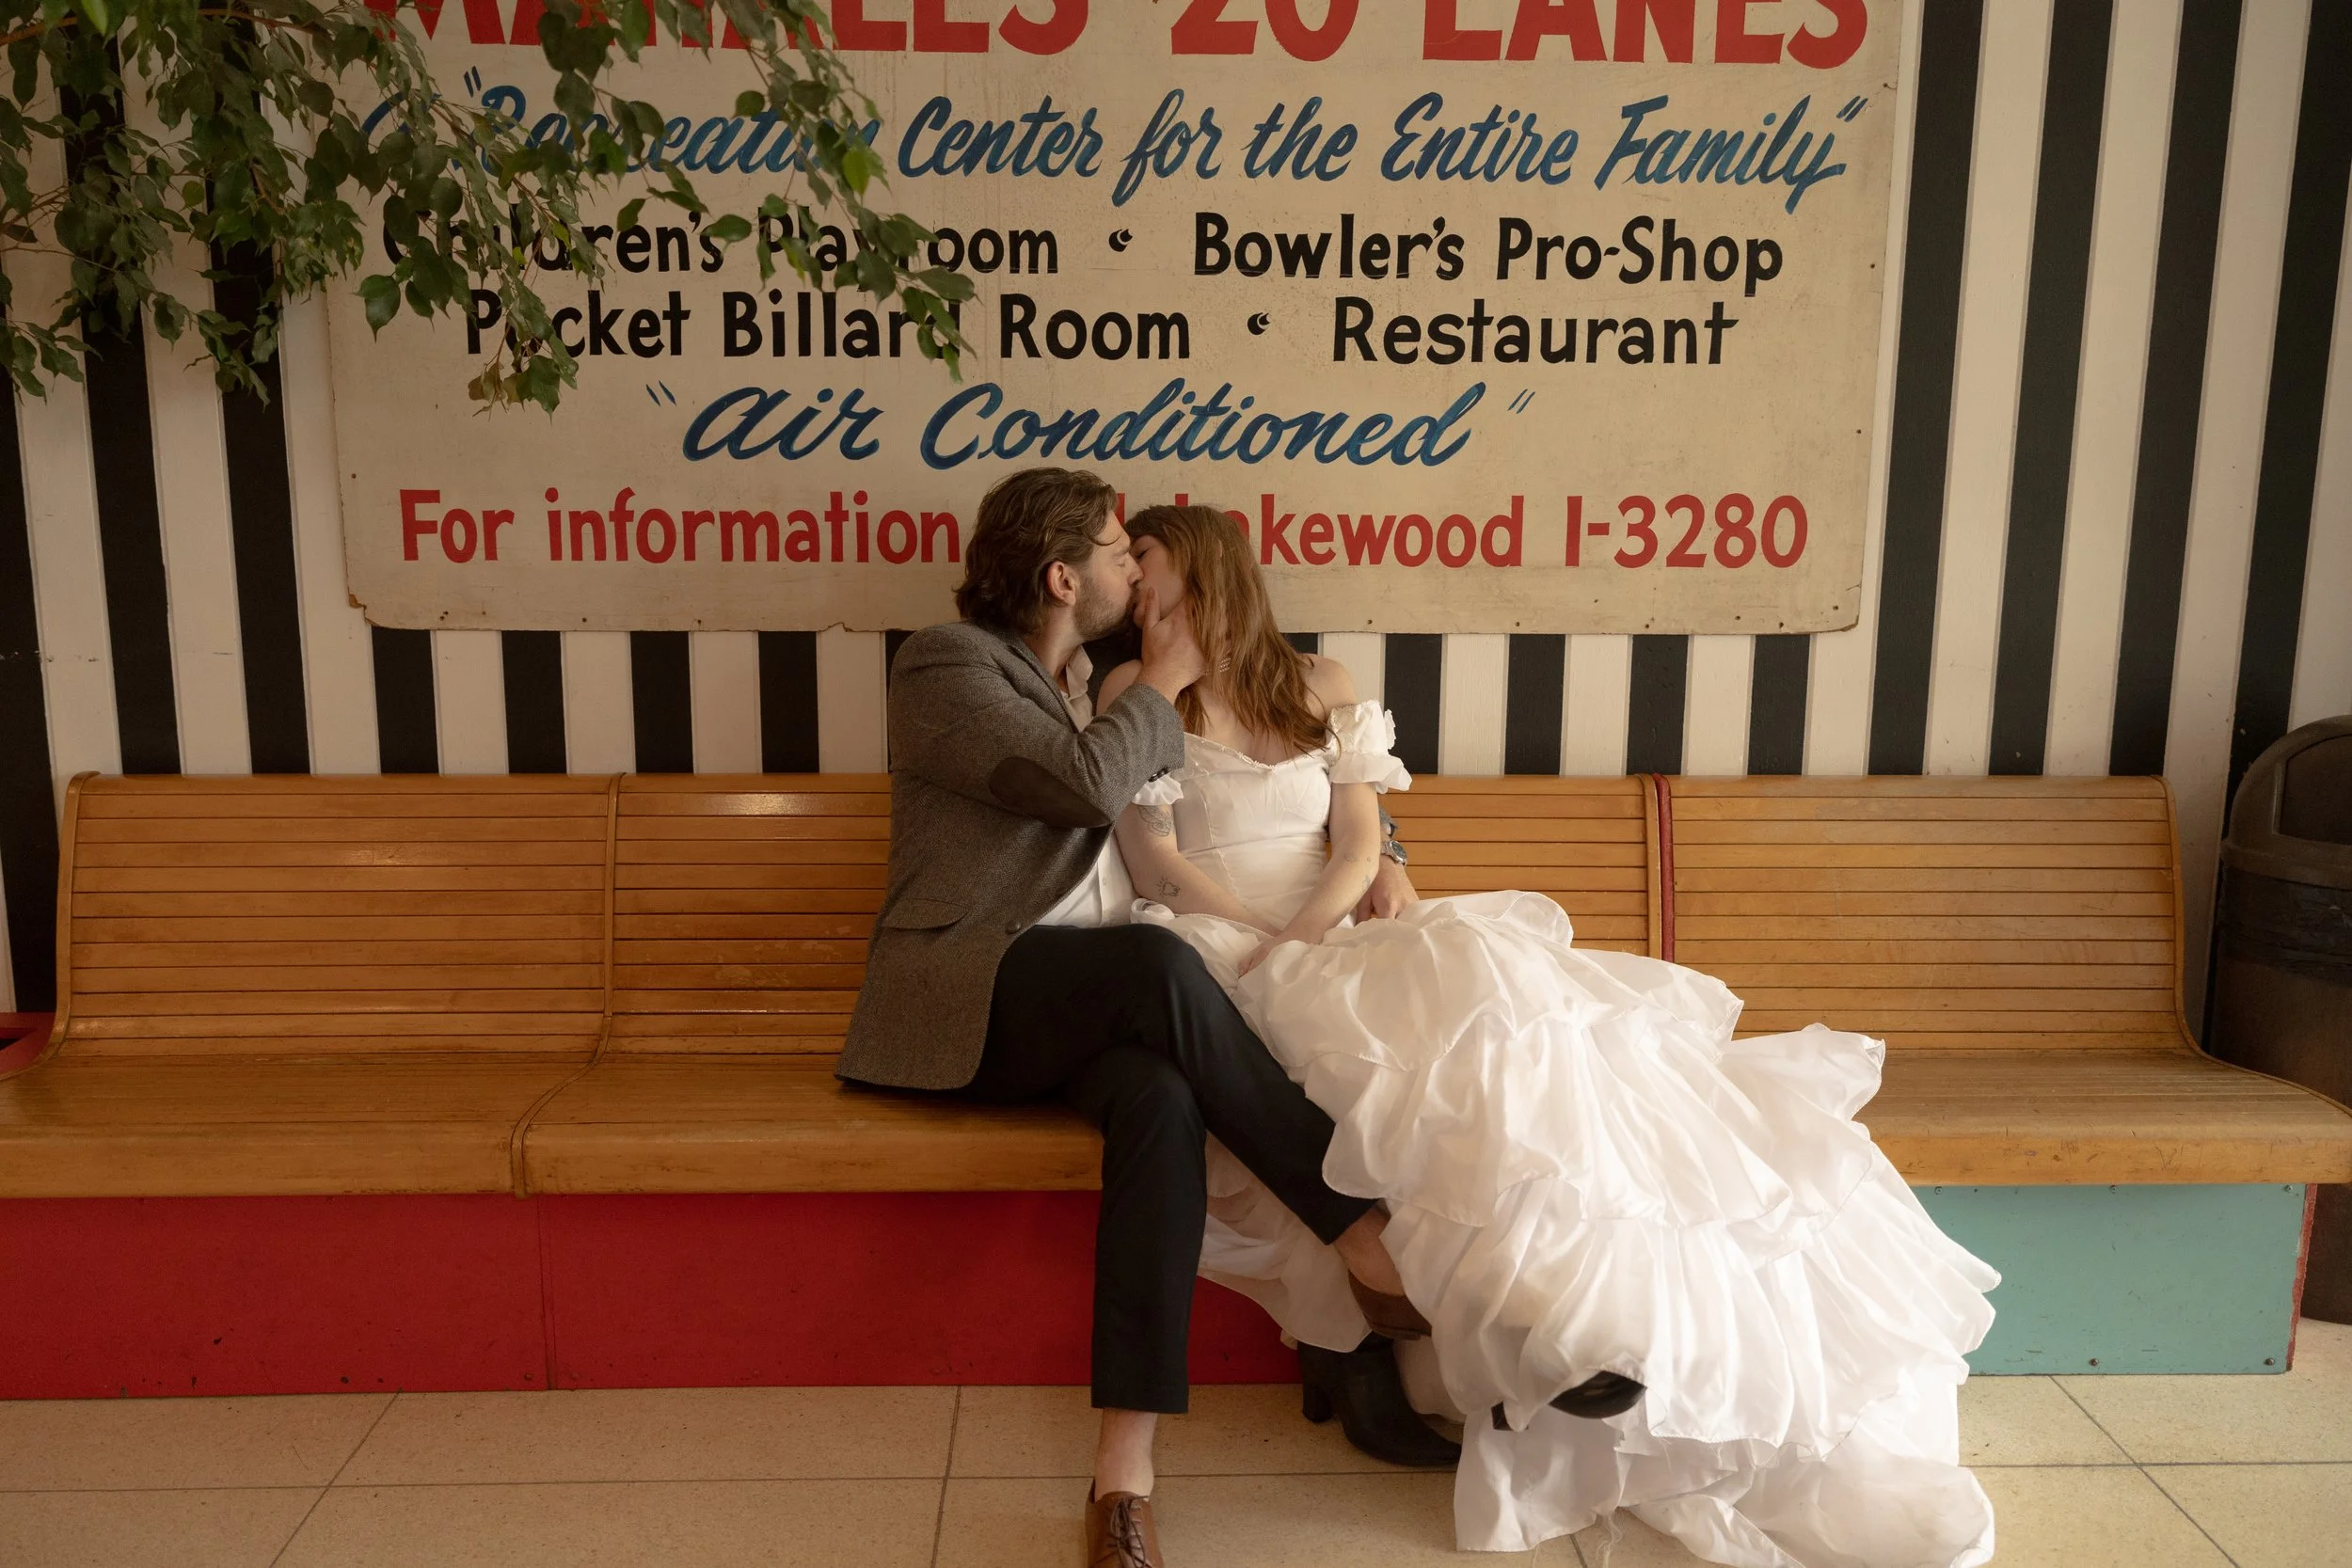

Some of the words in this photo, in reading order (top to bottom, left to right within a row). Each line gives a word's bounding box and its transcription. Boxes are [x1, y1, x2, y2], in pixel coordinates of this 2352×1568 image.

[898, 95, 1103, 178] Center
[1112, 88, 1222, 207] for
[1245, 96, 1358, 182] the
[1381, 91, 1580, 185] Entire
[757, 205, 1058, 293] Paoom
[1193, 212, 1466, 281] Bowler's
[1497, 214, 1784, 297] Pro-Shop
[999, 293, 1191, 360] Room
[1332, 295, 1740, 365] Restaurant
[399, 488, 516, 563] For
[544, 486, 961, 564] information
[1175, 492, 1526, 569] kewood
